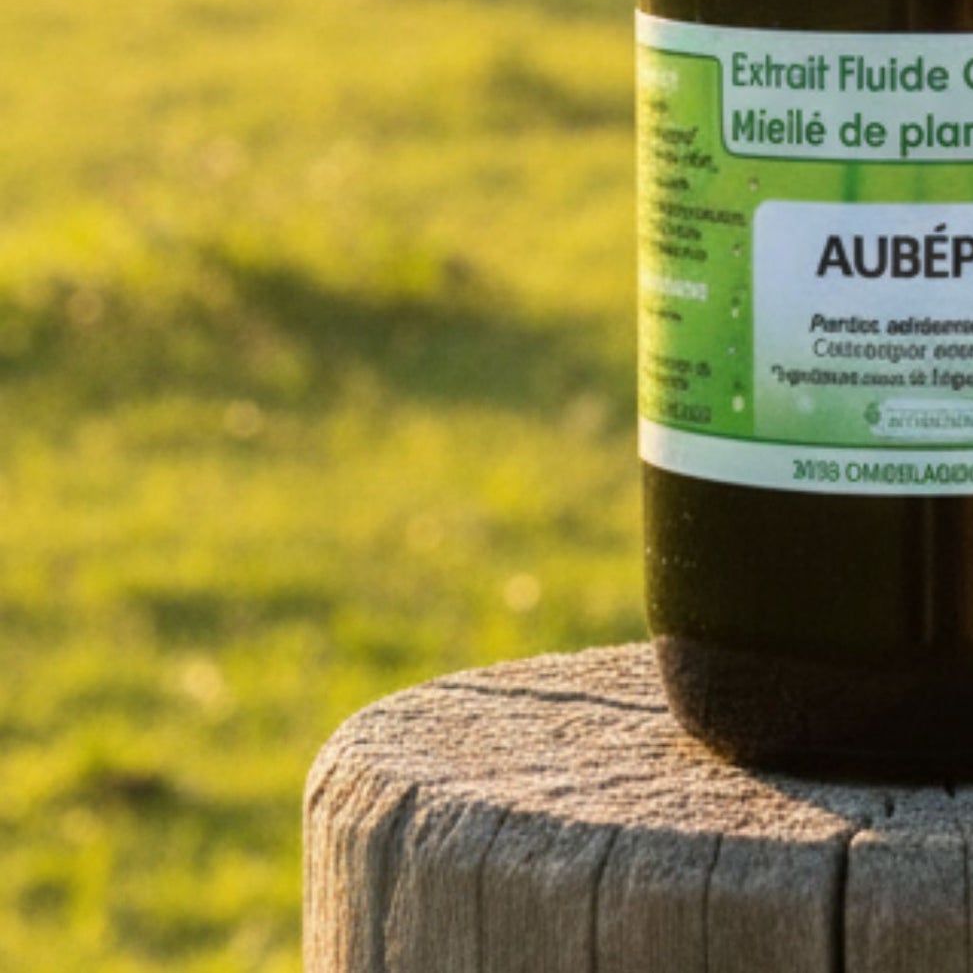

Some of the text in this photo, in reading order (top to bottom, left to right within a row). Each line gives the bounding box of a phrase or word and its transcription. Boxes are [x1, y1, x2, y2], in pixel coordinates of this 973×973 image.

[732, 52, 829, 90] Extrait
[838, 55, 950, 93] Fluide
[731, 109, 827, 146] Miellé
[839, 113, 887, 148] de
